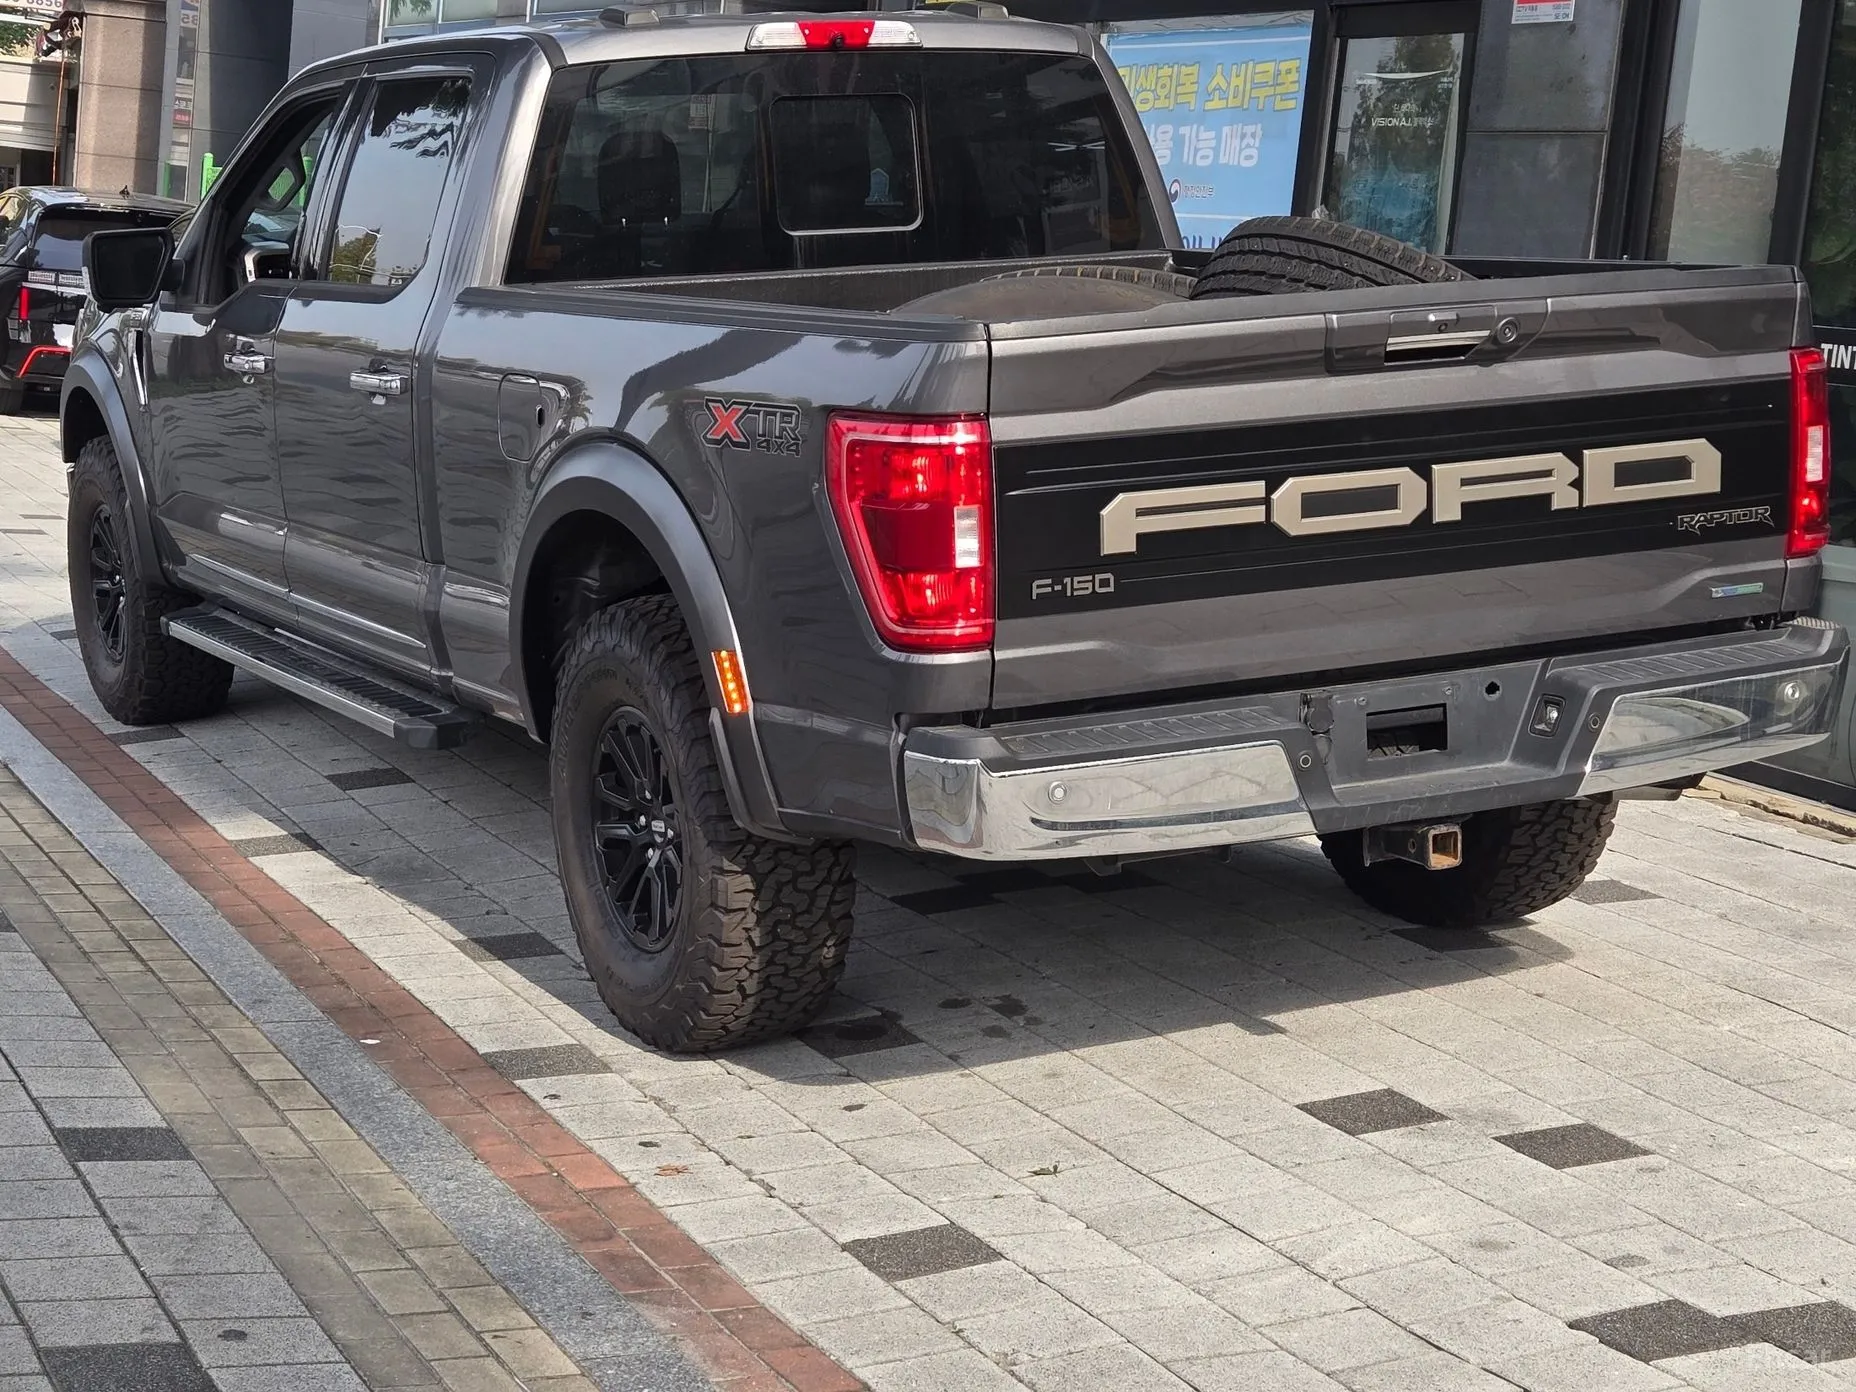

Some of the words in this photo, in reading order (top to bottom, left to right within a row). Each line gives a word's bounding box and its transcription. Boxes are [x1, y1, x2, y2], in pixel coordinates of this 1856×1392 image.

[1203, 57, 1301, 113] 소비쿠폰
[1178, 123, 1217, 167] 가능
[1218, 122, 1263, 168] 매장
[700, 396, 802, 452] XTR
[1100, 437, 1722, 556] FORD
[1677, 505, 1775, 536] RAPTOR
[1031, 572, 1115, 600] F-150
